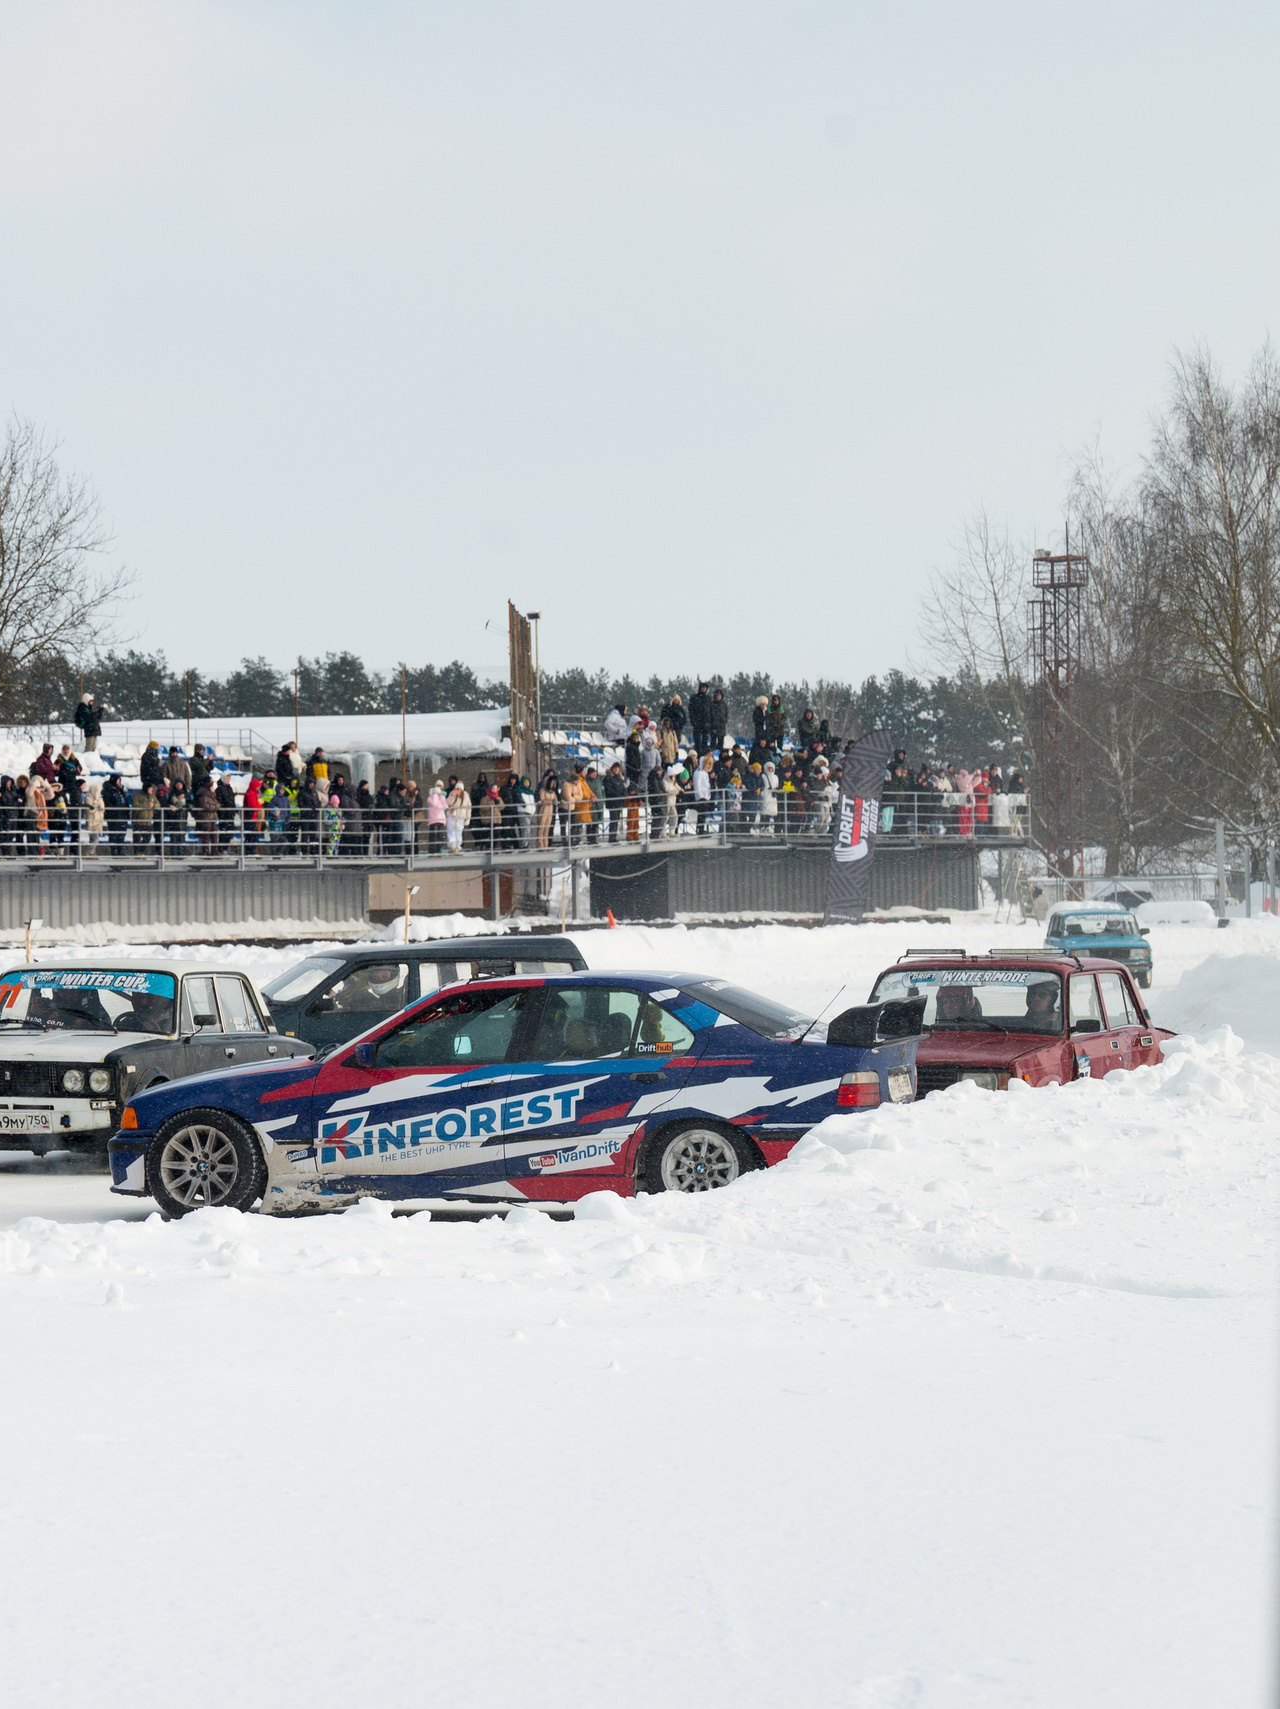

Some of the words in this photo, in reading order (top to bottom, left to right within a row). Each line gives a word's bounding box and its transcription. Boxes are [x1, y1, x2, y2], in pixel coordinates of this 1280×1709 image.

[838, 794, 855, 844] DRIFT
[60, 973, 115, 987] WINTER
[113, 975, 146, 988] CUP
[940, 971, 992, 983] WINTER
[991, 971, 1030, 983] MODE
[28, 1115, 47, 1125] 750
[379, 1154, 398, 1163] THE
[400, 1149, 422, 1160] BEST
[425, 1144, 446, 1155] UHP
[447, 1141, 472, 1151] TYRE
[558, 1140, 621, 1164] IvanDrift
